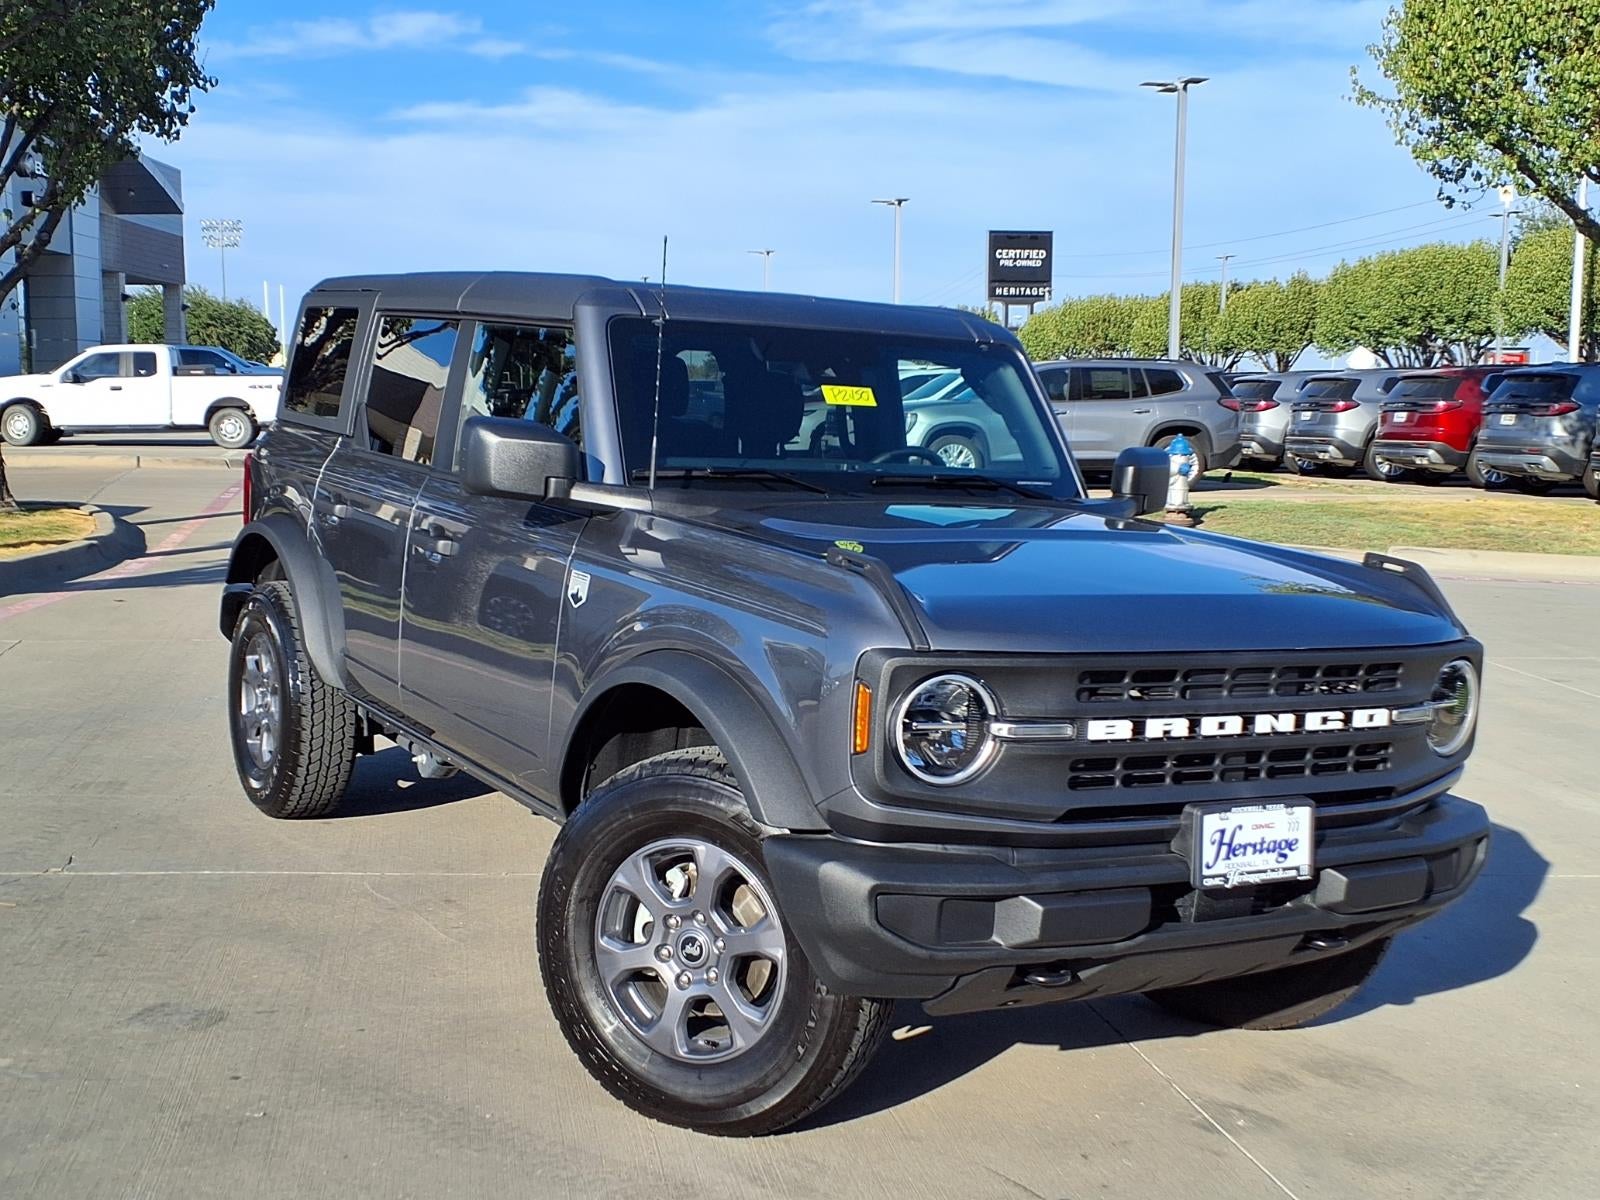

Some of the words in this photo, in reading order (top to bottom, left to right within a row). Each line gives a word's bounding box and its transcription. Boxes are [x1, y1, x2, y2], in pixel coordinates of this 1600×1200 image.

[995, 249, 1047, 259] CERTIFIED
[1000, 259, 1042, 267] PRE-OWNED
[995, 287, 1046, 296] HERITAGE
[1087, 708, 1391, 741] BRONCO
[1251, 823, 1275, 831] GMC
[1205, 824, 1299, 870] Heritage
